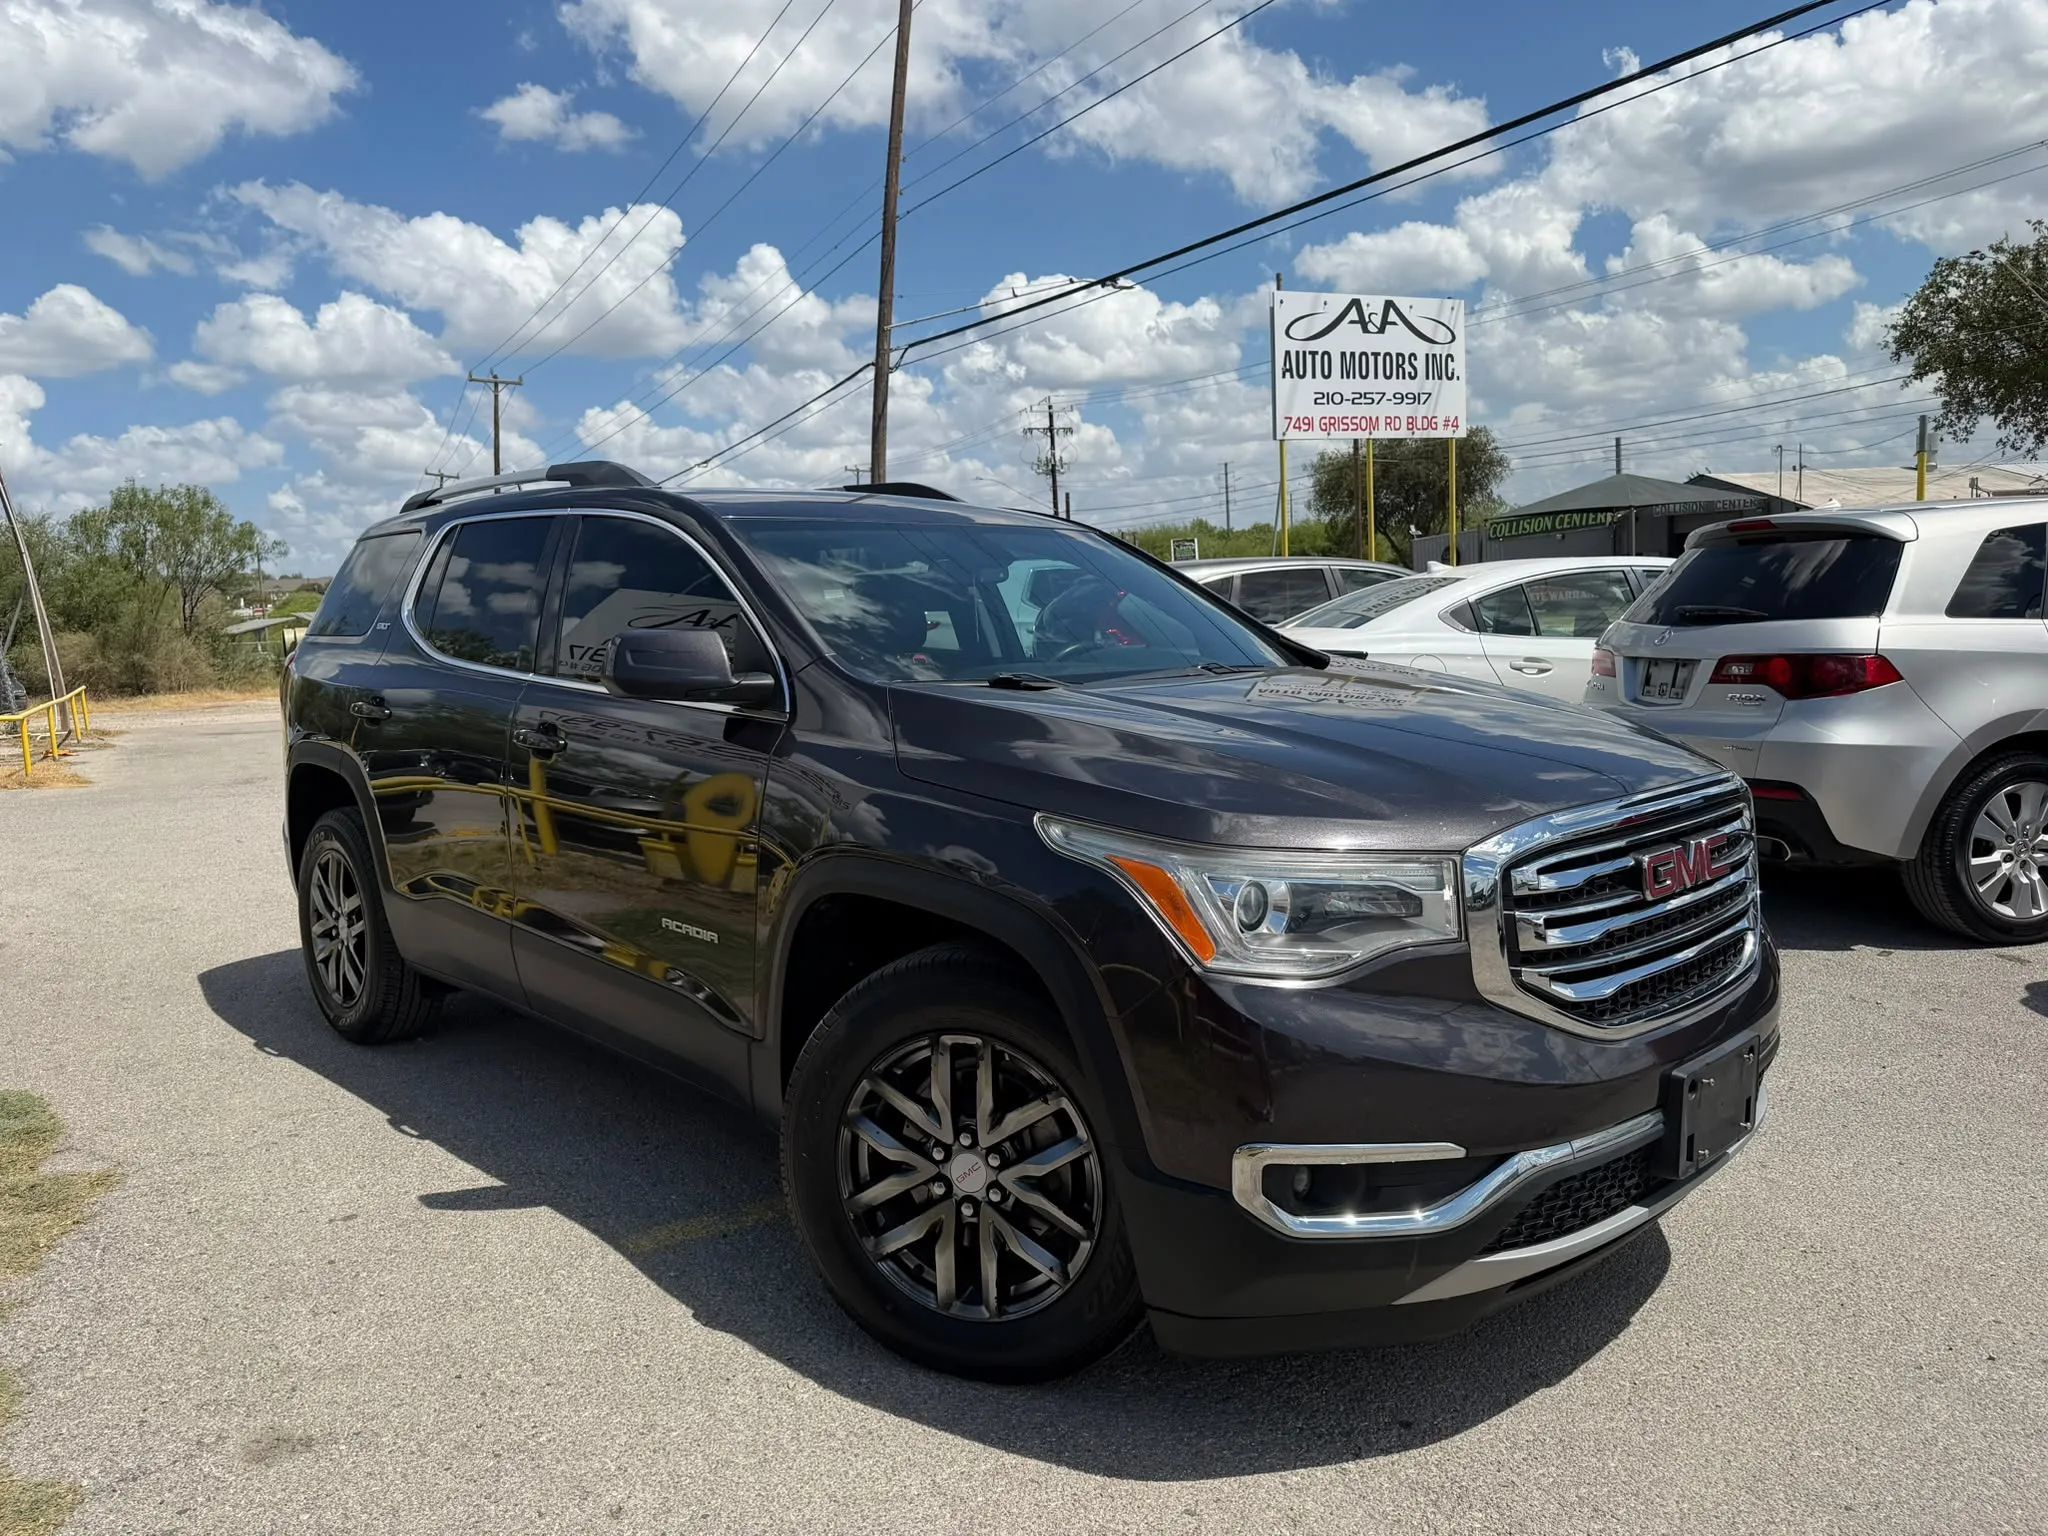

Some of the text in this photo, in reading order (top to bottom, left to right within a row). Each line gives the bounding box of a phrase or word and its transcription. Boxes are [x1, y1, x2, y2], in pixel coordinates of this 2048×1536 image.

[1281, 350, 1461, 381] AUTO MOTORS INC.
[1313, 391, 1432, 406] 210-257-9917
[1284, 415, 1460, 432] 7491 GRISSOM RD BLDG #4
[1652, 500, 1706, 517] COLLISION
[1489, 516, 1553, 538] COLLISION
[1643, 831, 1732, 901] GMC
[661, 917, 719, 944] ACADIA
[956, 1161, 982, 1184] GMC
